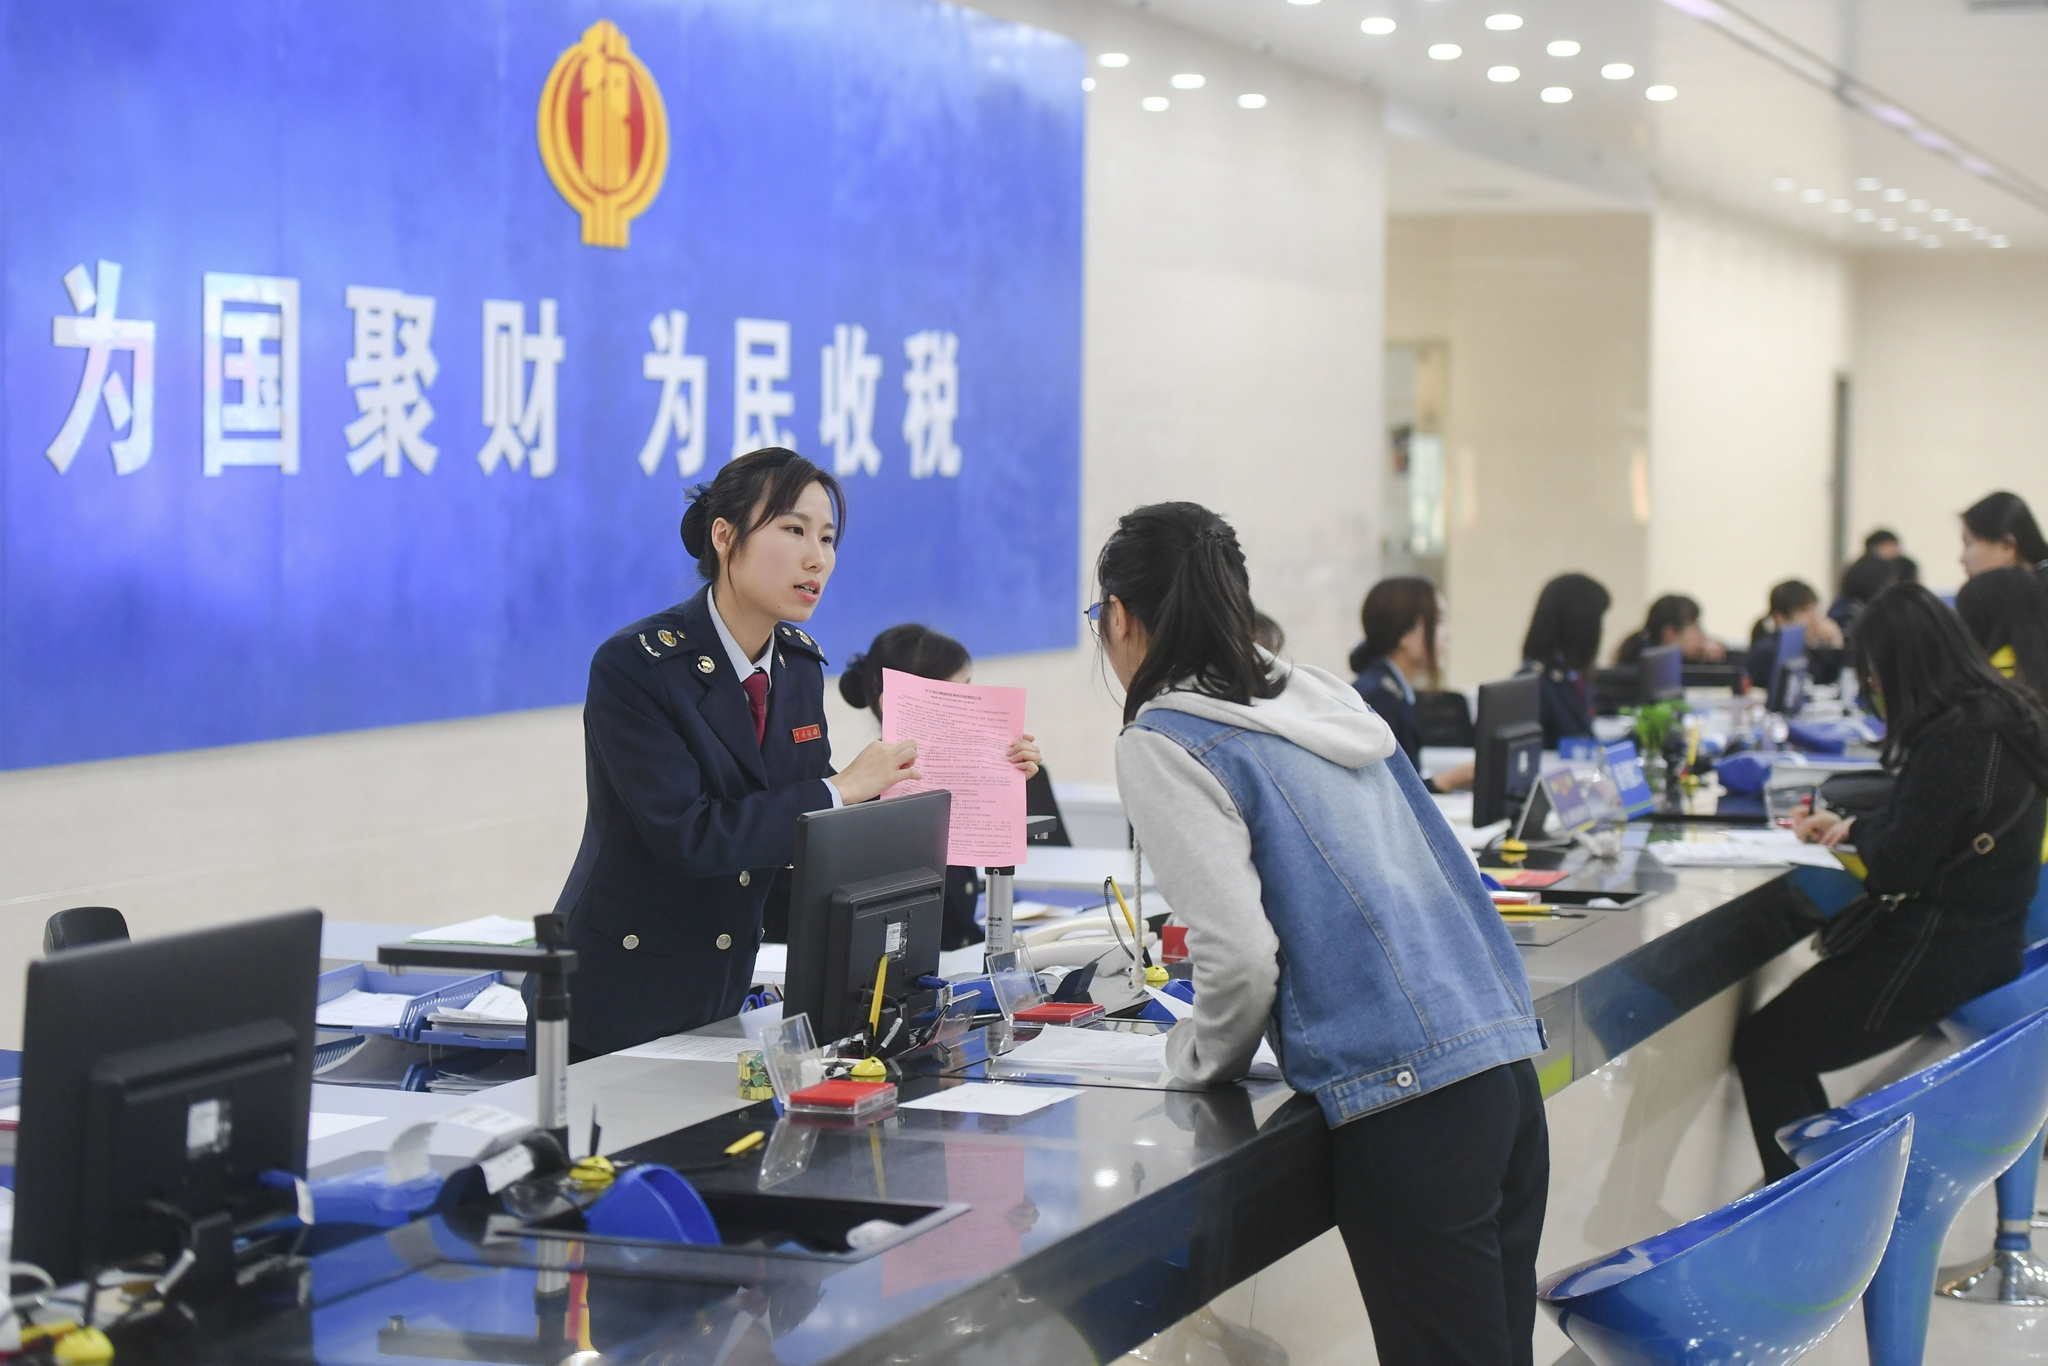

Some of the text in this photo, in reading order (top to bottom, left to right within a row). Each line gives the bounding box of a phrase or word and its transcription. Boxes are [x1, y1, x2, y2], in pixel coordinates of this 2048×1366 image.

[45, 259, 963, 479] 为国聚财 为民收税
